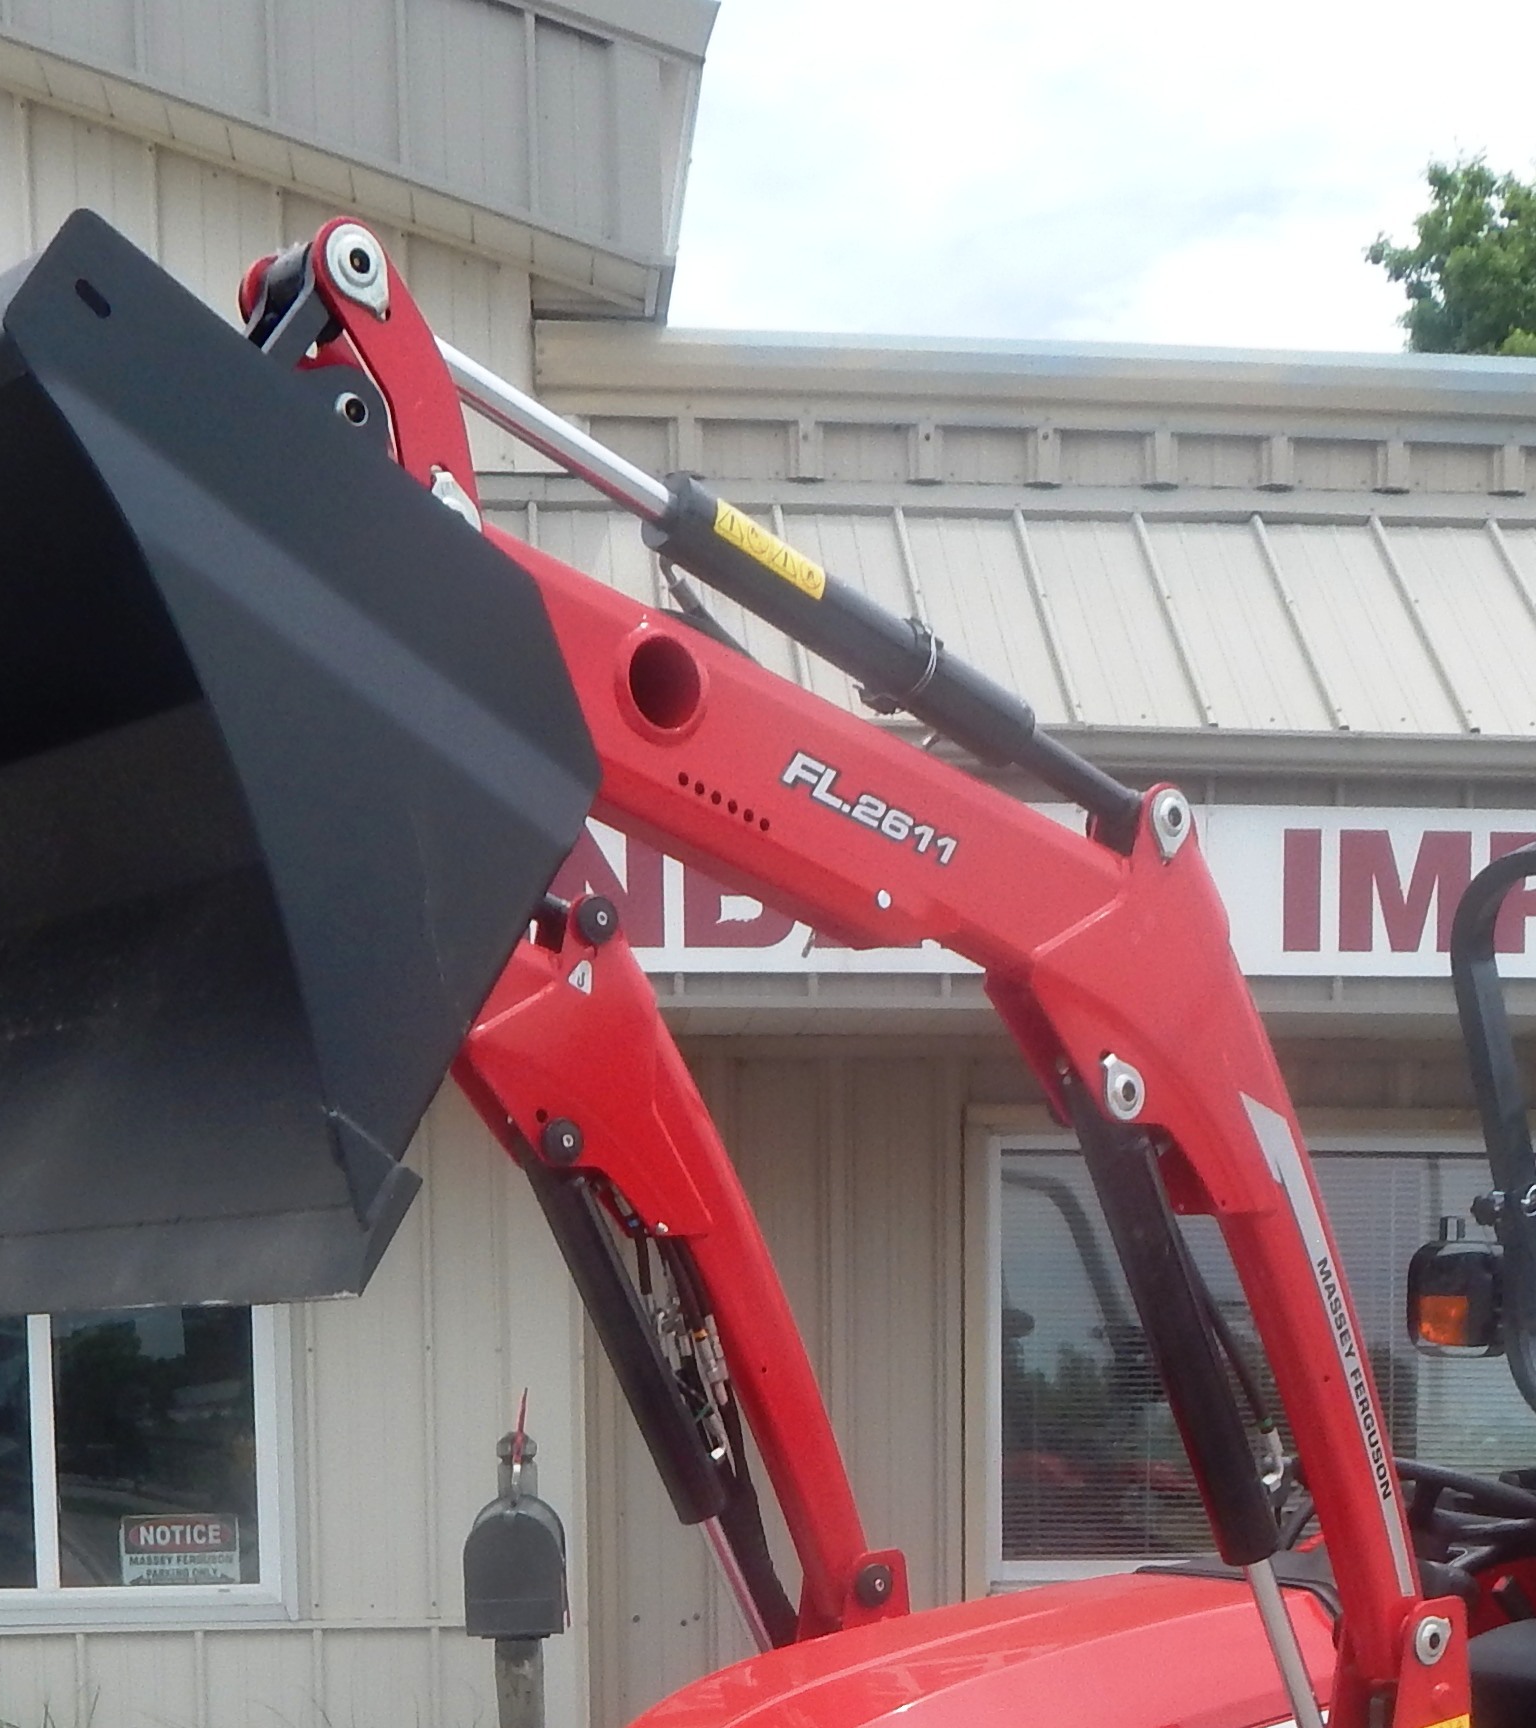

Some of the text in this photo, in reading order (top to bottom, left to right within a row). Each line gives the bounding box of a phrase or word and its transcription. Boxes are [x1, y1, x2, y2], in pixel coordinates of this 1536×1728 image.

[781, 751, 958, 865] FL.2611
[1317, 1256, 1392, 1501] MASSEY FERGUSON
[139, 1524, 221, 1546] NOTICE
[129, 1554, 234, 1566] MASSEY FERGUSON
[192, 1567, 221, 1577] ONLY
